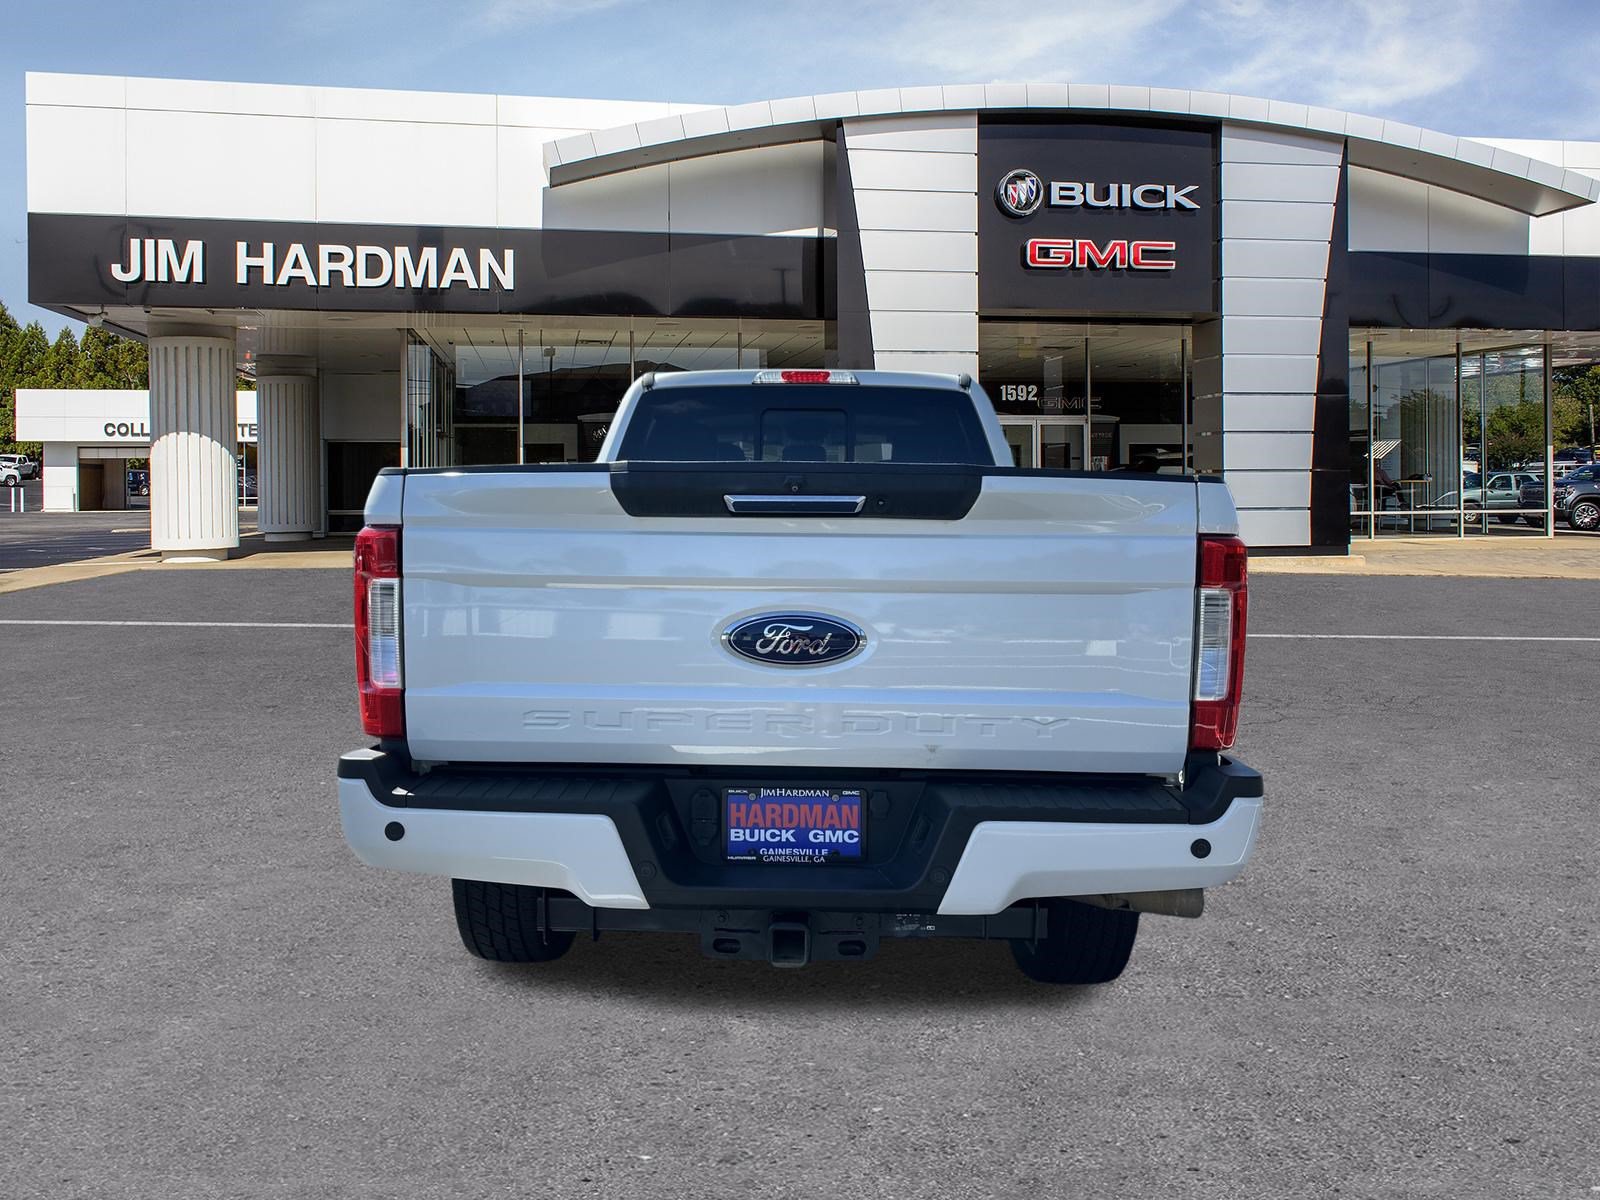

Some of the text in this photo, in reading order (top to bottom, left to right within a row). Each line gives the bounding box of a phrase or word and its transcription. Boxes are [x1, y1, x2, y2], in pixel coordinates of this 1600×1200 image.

[1050, 181, 1200, 209] BUICK
[111, 238, 515, 290] JIM HARDMAN
[1026, 238, 1176, 270] GMC
[1000, 384, 1038, 401] 1592
[1037, 396, 1103, 409] GMC
[755, 623, 833, 656] Ford
[522, 710, 1070, 738] SUPER DUTY
[730, 803, 859, 829] HARDMAN
[730, 828, 860, 843] BUICK GMC
[759, 848, 829, 856] GAINESVILLE
